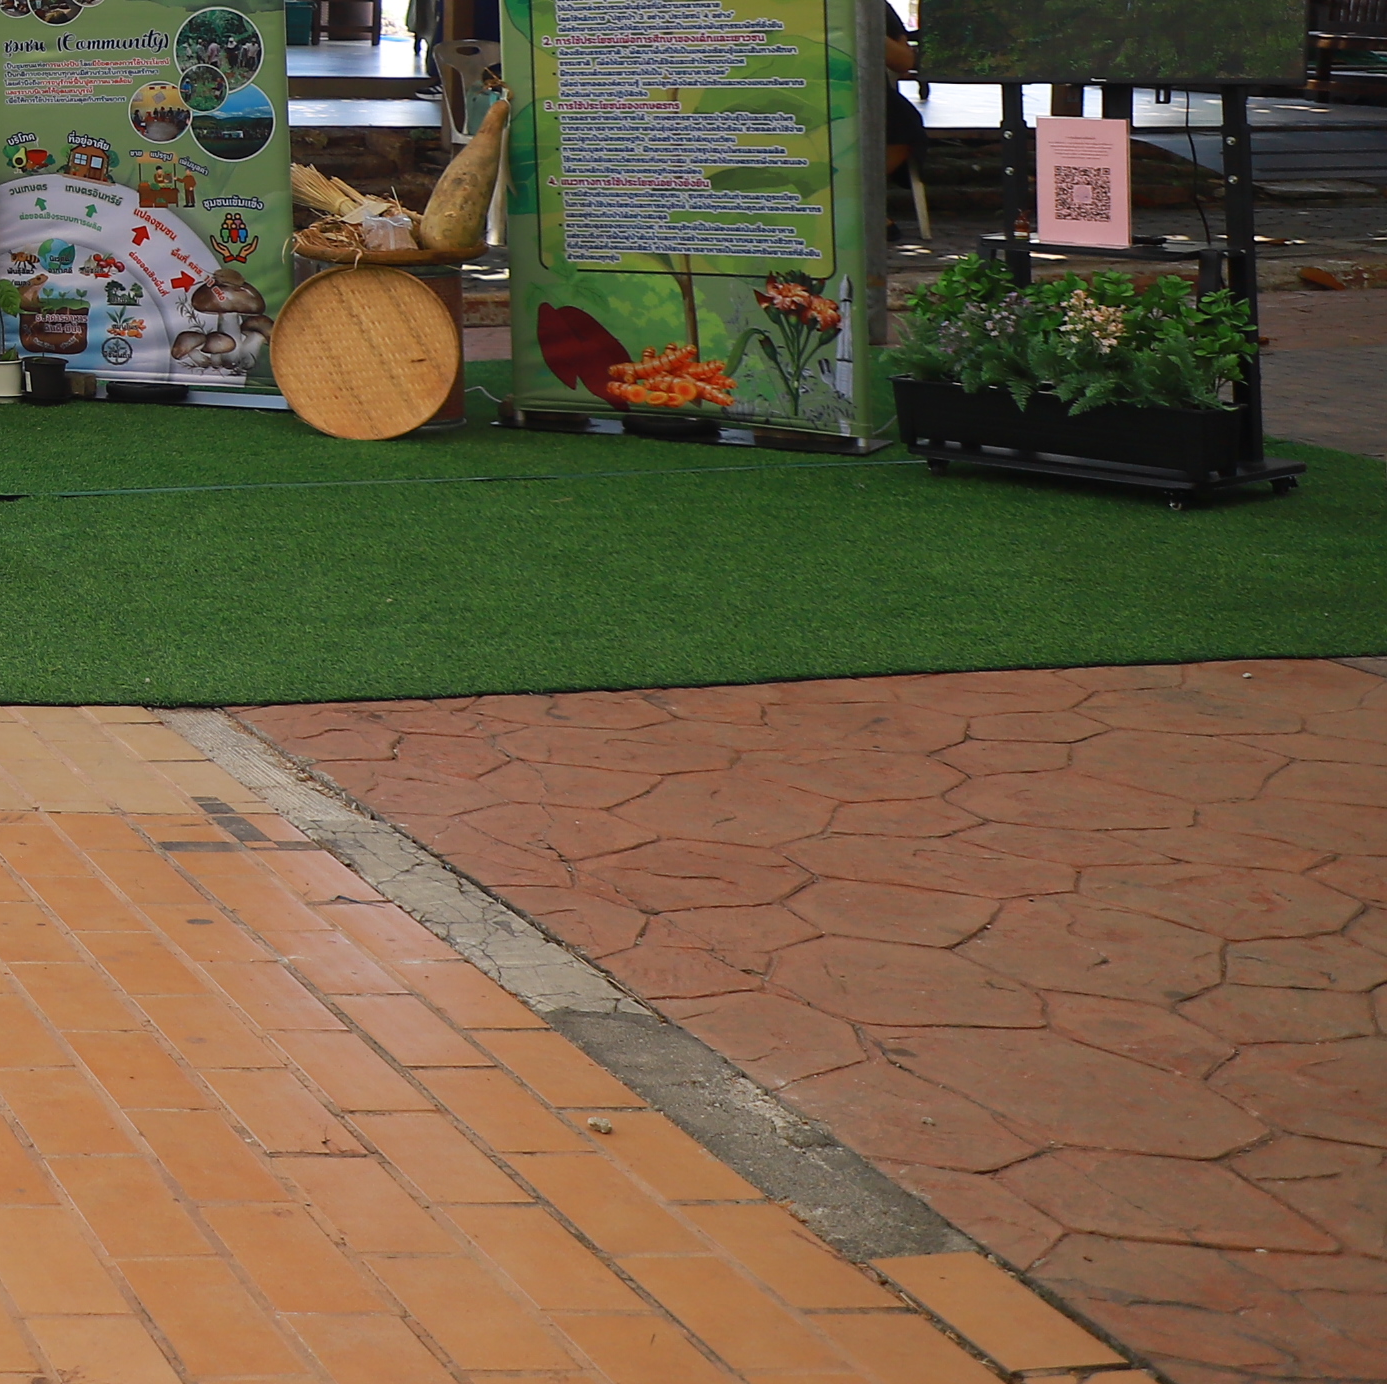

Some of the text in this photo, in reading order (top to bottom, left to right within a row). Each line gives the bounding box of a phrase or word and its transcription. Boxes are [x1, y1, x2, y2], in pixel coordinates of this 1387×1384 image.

[3, 28, 170, 58] ชุมชน (Community)
[7, 132, 36, 146] บริโภค
[68, 131, 110, 151] ที่อยู่อาศัย
